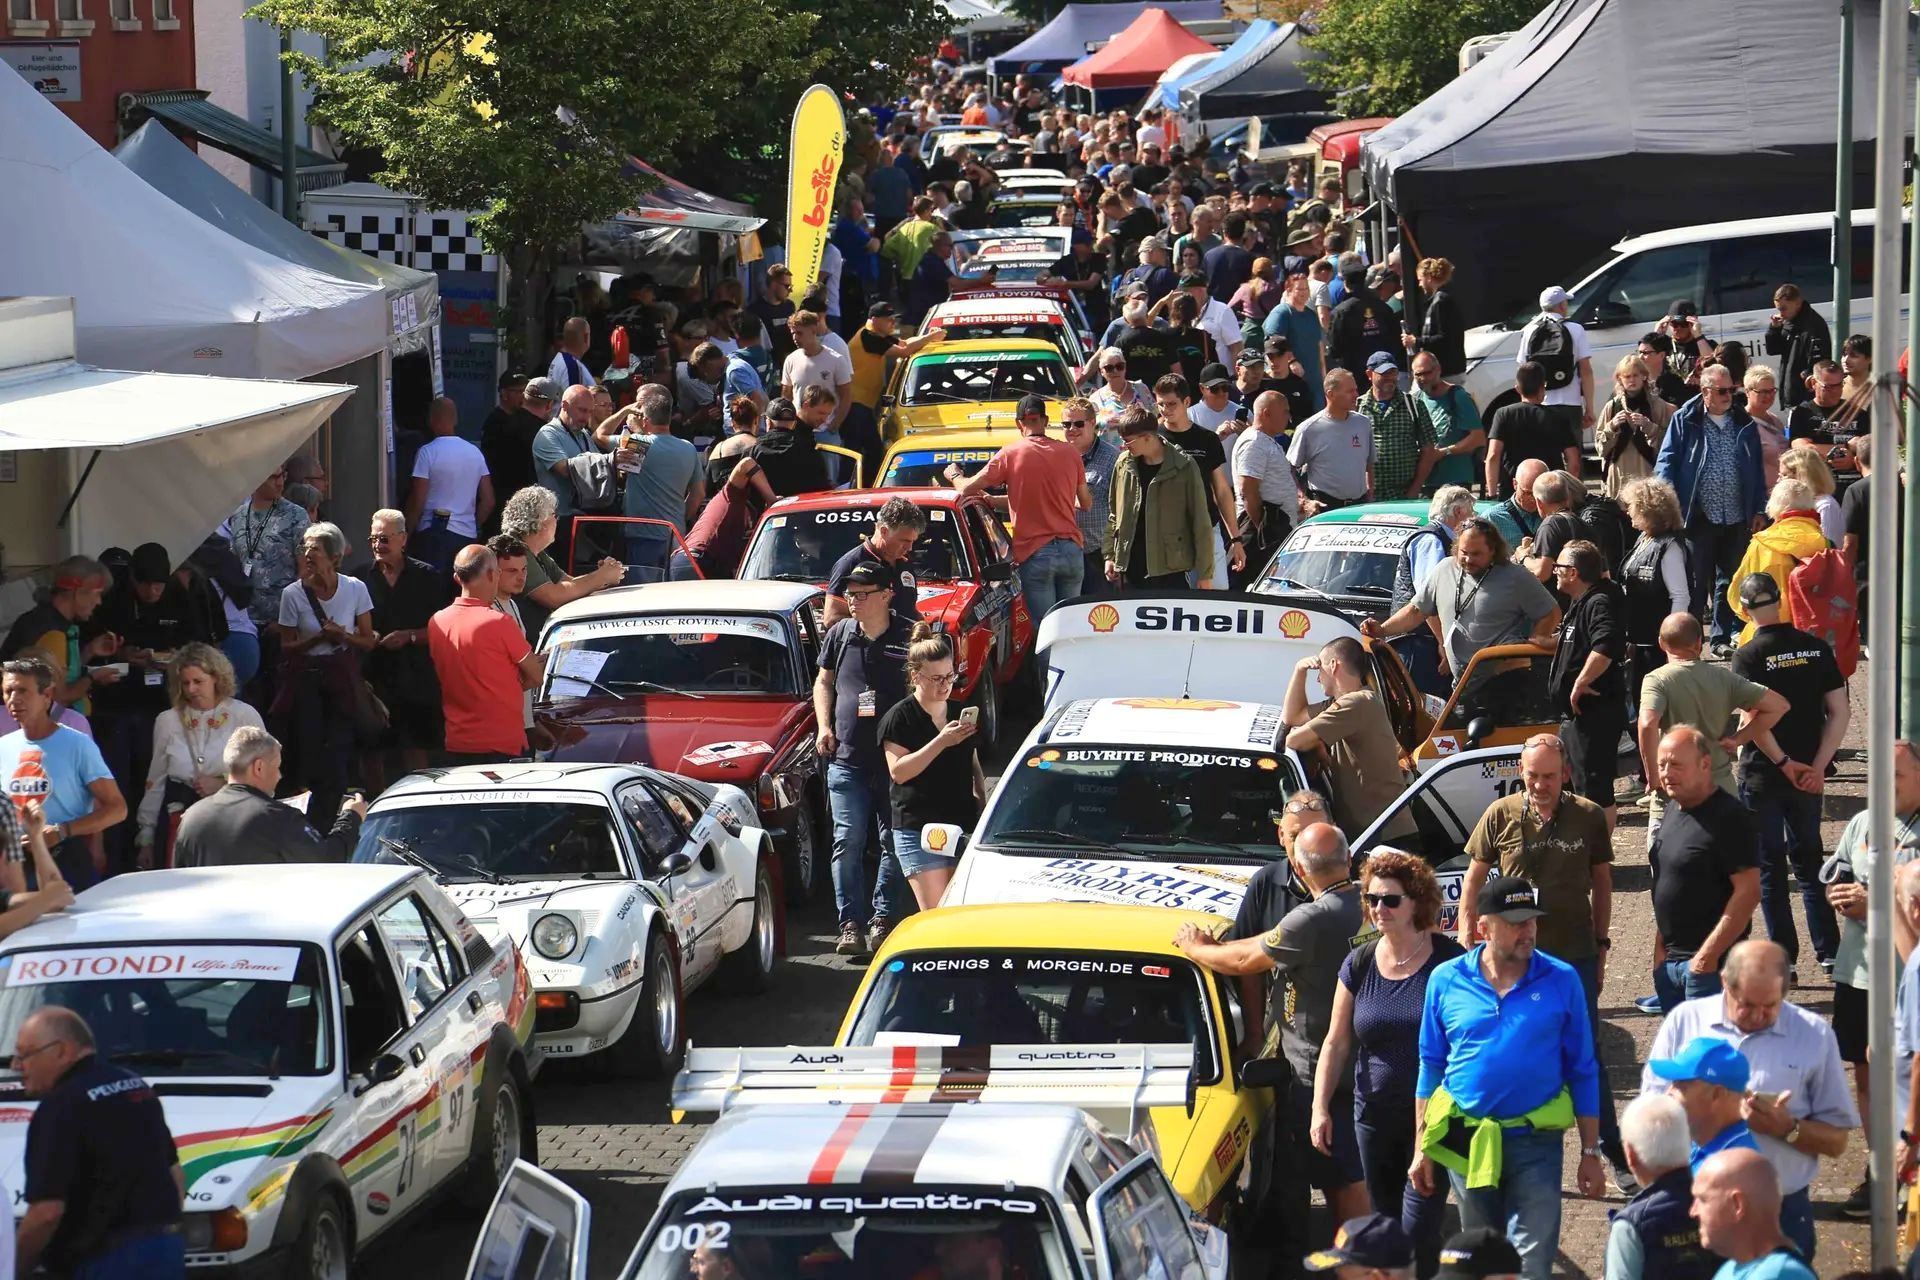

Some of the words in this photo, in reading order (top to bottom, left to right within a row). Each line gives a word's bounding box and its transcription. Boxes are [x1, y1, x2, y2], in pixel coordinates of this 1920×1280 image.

[968, 291, 995, 300] TEAM
[997, 290, 1043, 298] TOYOTA
[1044, 291, 1060, 299] GB
[959, 314, 1034, 324] MITSUBISHI
[1339, 527, 1377, 535] FORD
[1314, 533, 1371, 548] Eduardo
[588, 617, 740, 631] WWW.CLASSIC-ROVER.NL
[1134, 606, 1264, 635] Shell
[1066, 750, 1146, 762] BUYRITE
[1149, 751, 1252, 769] PRODUCTS
[10, 780, 49, 792] Gulf
[1044, 858, 1246, 906] BUYRITE
[1055, 872, 1191, 908] PRODUCTS
[17, 955, 186, 980] ROTONDI
[912, 959, 990, 973] KOENIGS
[1001, 958, 1014, 970] &
[1026, 959, 1133, 974] MORGEN.DE
[790, 1053, 844, 1064] Audi
[1017, 1051, 1117, 1062] quattro
[684, 1194, 813, 1215] Audi
[819, 1193, 1037, 1214] quattro
[657, 1221, 732, 1253] 002
